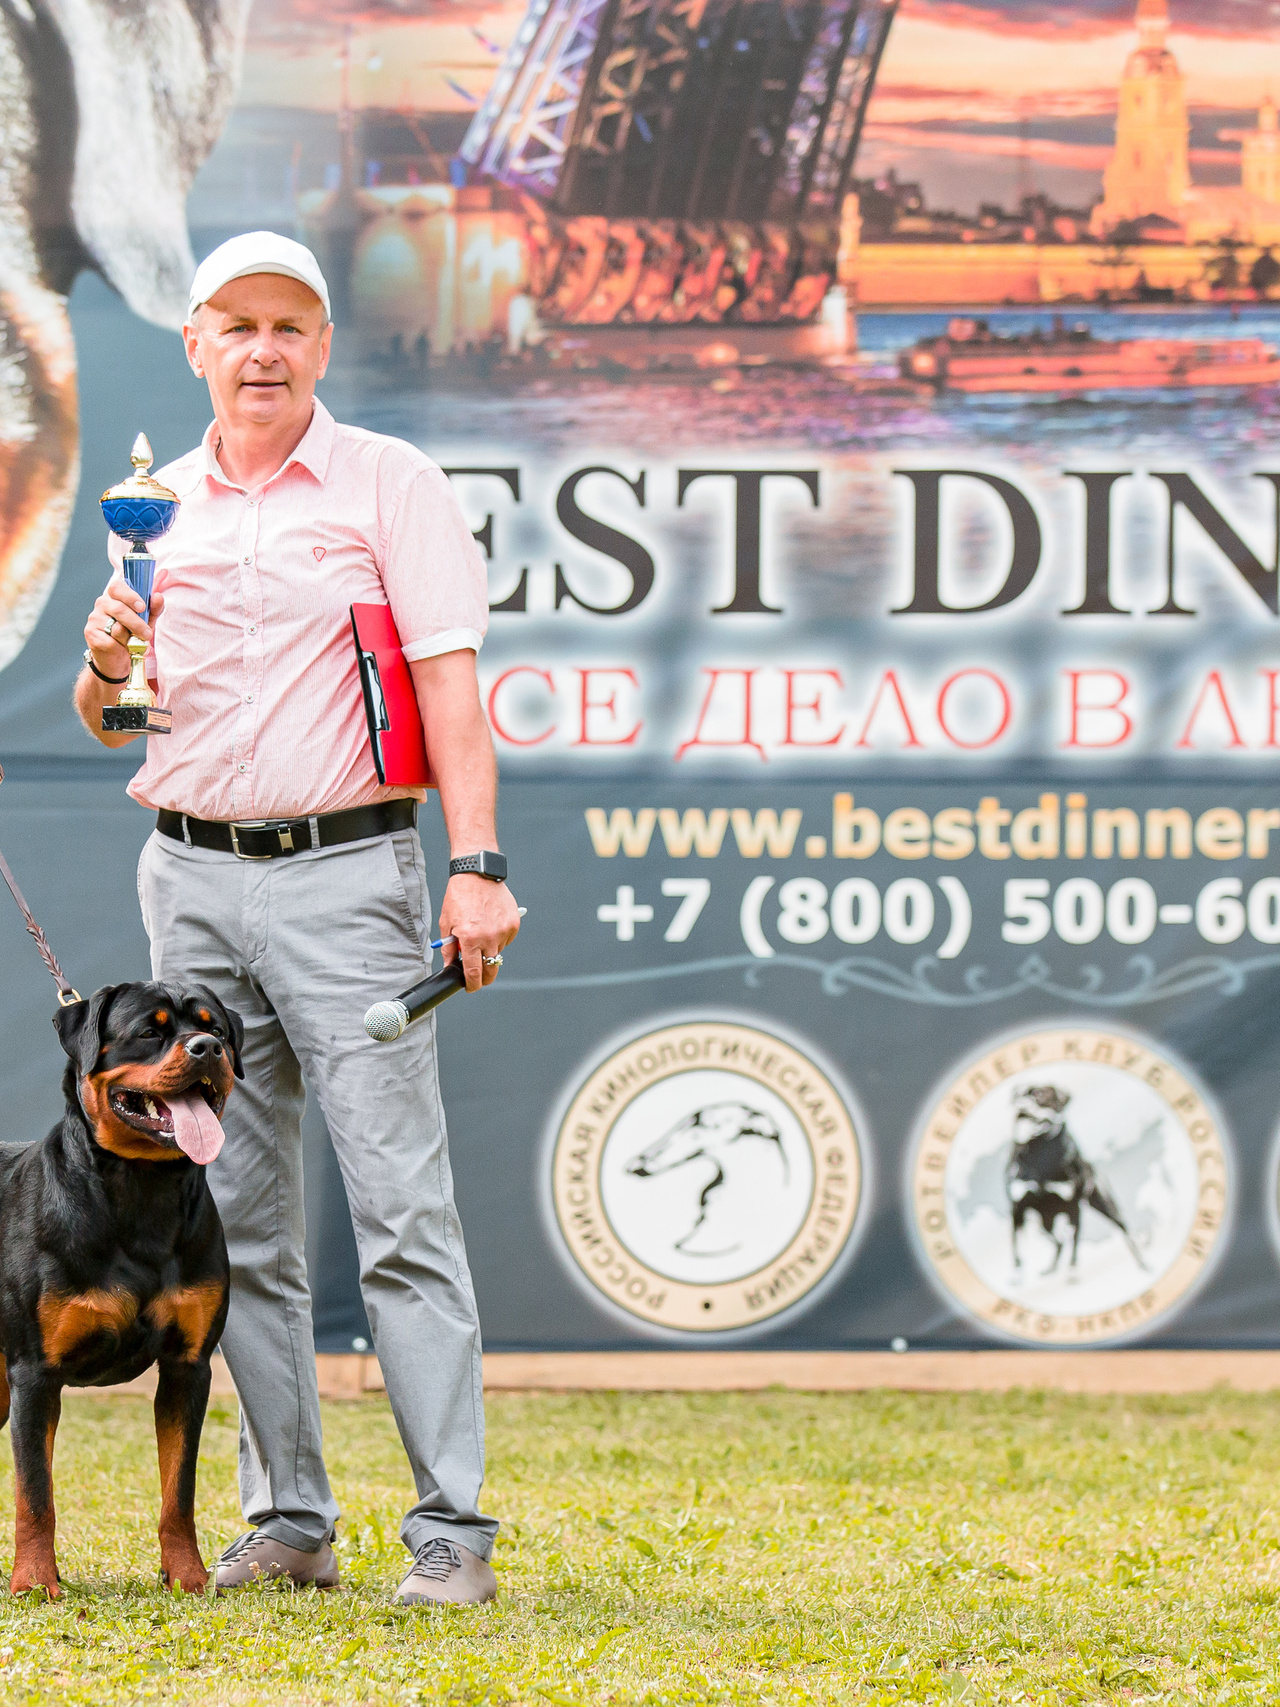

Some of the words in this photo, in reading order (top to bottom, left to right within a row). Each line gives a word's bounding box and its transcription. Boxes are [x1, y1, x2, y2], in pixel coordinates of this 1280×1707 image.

[441, 466, 821, 615] EST
[890, 470, 1280, 618] DIN
[487, 666, 643, 748] СЕ
[674, 667, 1014, 762] ДЕЛО
[1061, 669, 1134, 749] В
[1176, 667, 1280, 749] Л
[585, 793, 1280, 861] www.bestdinner
[596, 878, 712, 944] +7
[740, 875, 972, 958] (800)
[1001, 876, 1280, 945] 500-60
[1063, 1038, 1167, 1090] КЛУБ
[590, 1036, 839, 1138] КИНОЛОГИЧЕСКАЯ
[742, 1148, 849, 1311] ФЕДЕРАЦИЯ
